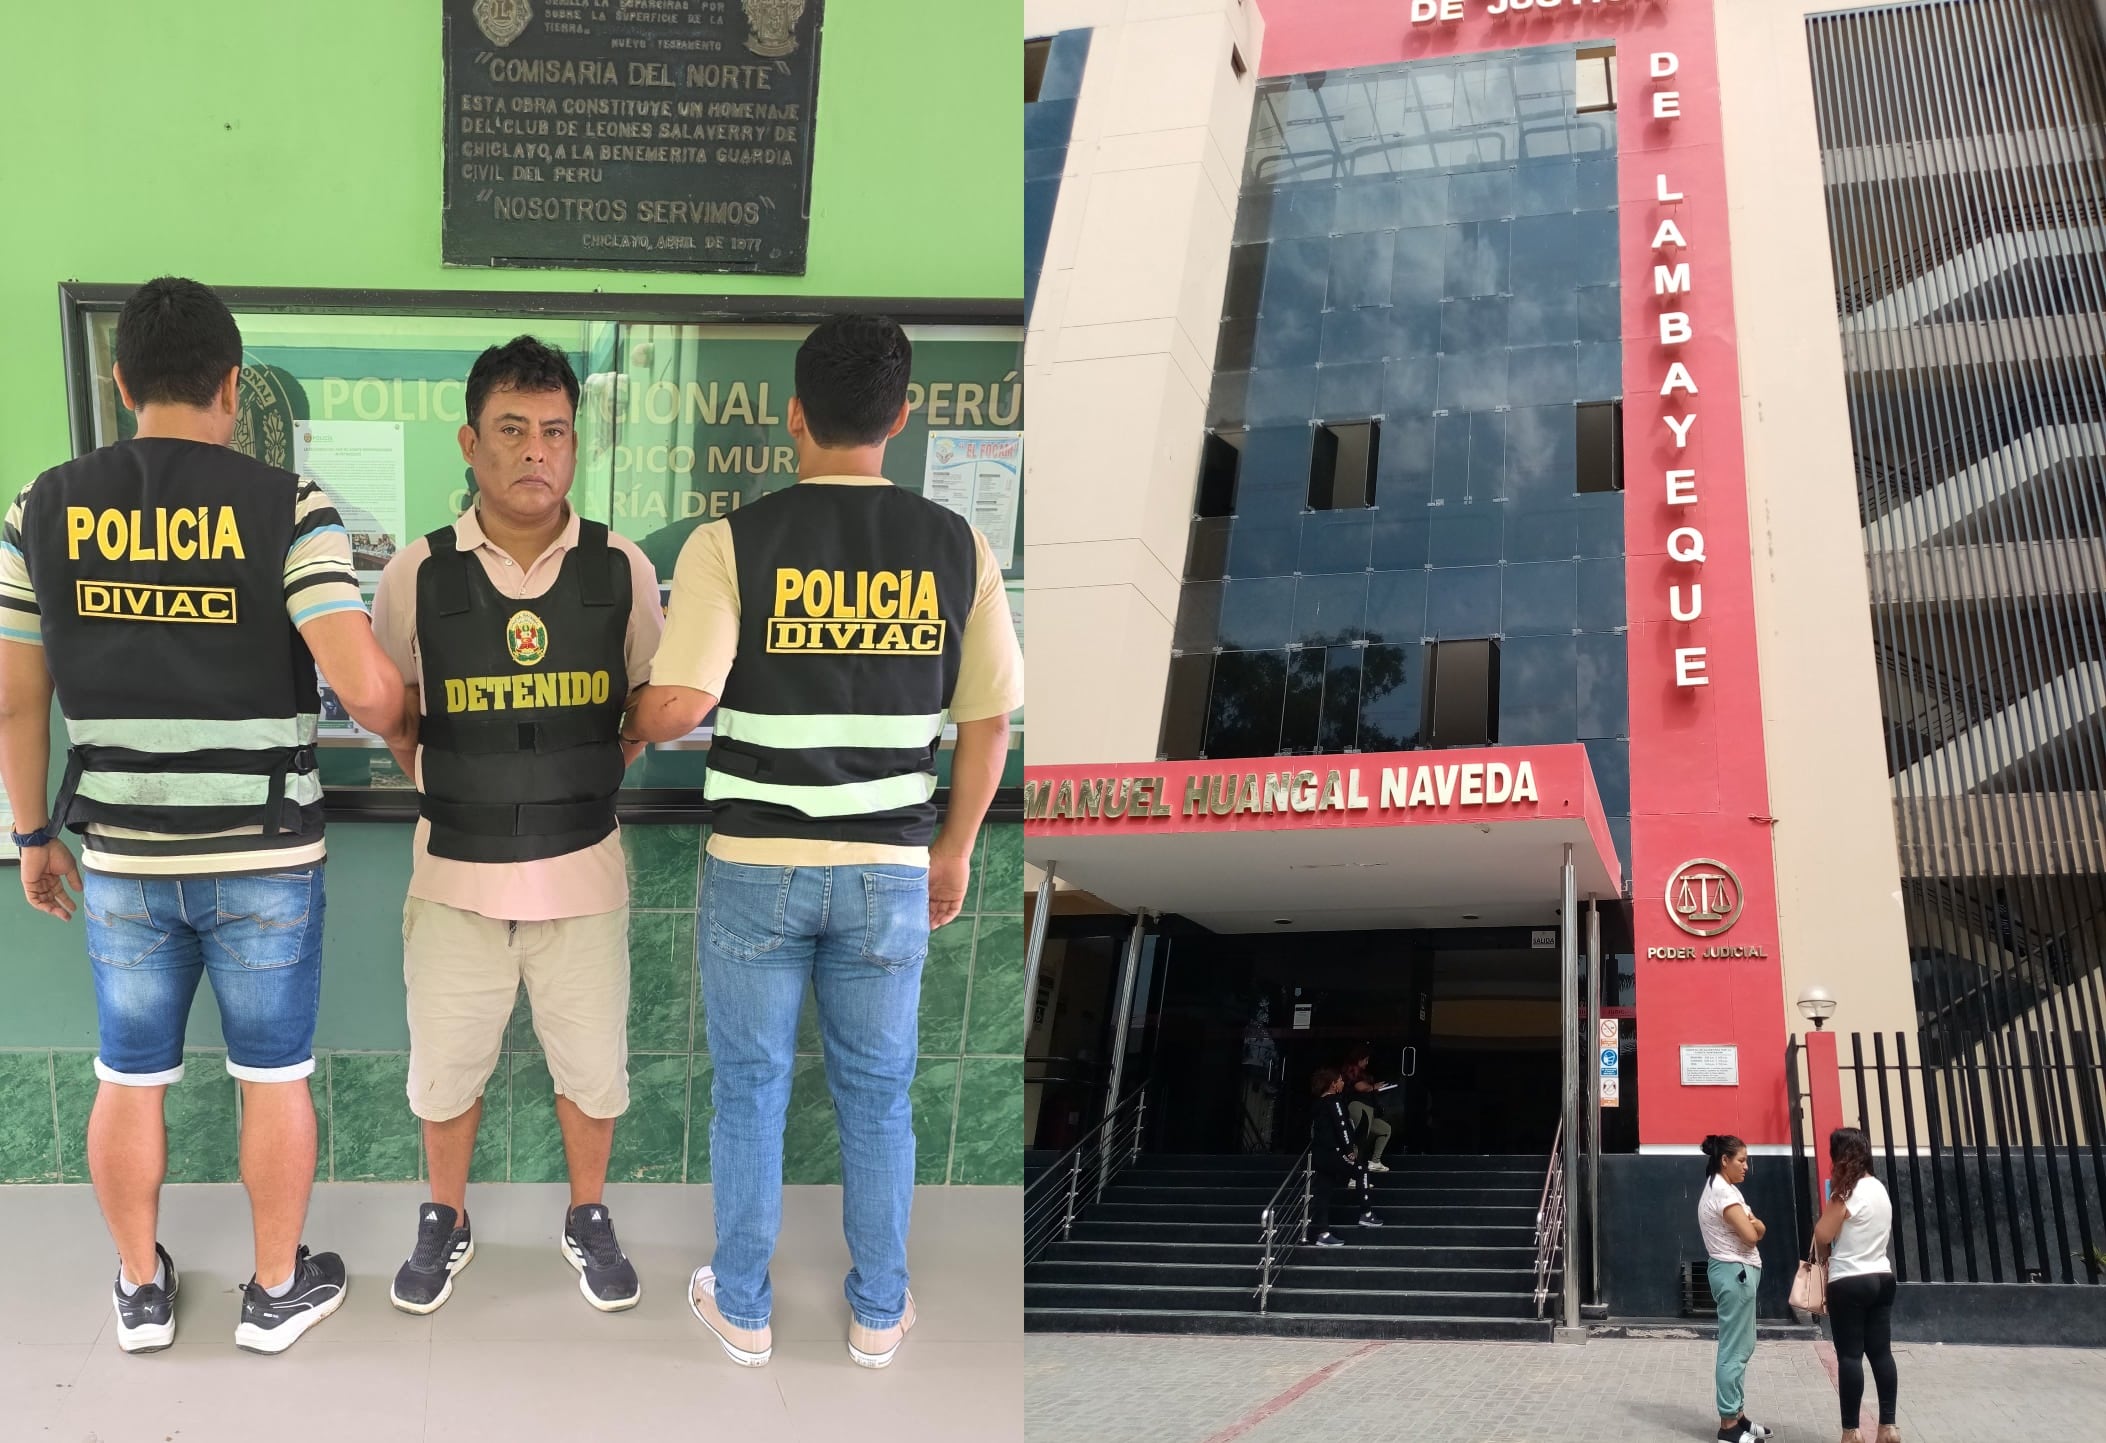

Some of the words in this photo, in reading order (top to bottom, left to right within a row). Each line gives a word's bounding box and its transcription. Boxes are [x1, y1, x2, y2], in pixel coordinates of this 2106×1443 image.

[592, 11, 606, 21] LA
[616, 11, 679, 24] SUPERFICIE
[710, 15, 724, 25] LA
[1410, 0, 1464, 24] DE
[611, 38, 646, 49] NUEVO
[628, 62, 676, 88] DEL
[1650, 52, 1681, 119] DE
[461, 94, 507, 113] ESTA
[512, 96, 558, 114] OBRA
[562, 98, 673, 118] CONSTITUYE
[678, 101, 704, 118] UN
[708, 102, 800, 120] HOMENAJE
[503, 119, 549, 136] CLUB
[556, 120, 579, 137] DE
[585, 120, 653, 138] LEONES
[658, 122, 767, 142] SALAVERRY
[775, 126, 798, 143] DE
[571, 144, 595, 161] LA
[600, 144, 707, 164] BENEMERITA
[716, 147, 793, 166] GUARDIA
[461, 163, 505, 183] CIVIL
[512, 165, 545, 182] DEL
[553, 166, 603, 183] PERU
[657, 235, 697, 250] ABRIL
[704, 236, 725, 250] DE
[243, 367, 272, 402] ONAL
[323, 376, 462, 422] POLIC
[581, 381, 779, 426] CIONAL
[1651, 174, 1710, 687] LAMBAYEQUE
[708, 446, 799, 474] MUR
[67, 505, 246, 562] POLICÍA
[84, 586, 230, 619] DIVIAC
[774, 567, 939, 620] POLICÍA
[775, 623, 938, 650] DIVIAC
[444, 670, 610, 713] DETENIDO
[1024, 776, 1172, 820] MANUEL
[1182, 769, 1369, 816] HUANGAL
[1380, 760, 1539, 810] NAVEDA
[1647, 947, 1696, 960] PODER
[1702, 945, 1768, 959] JUDICIAL
